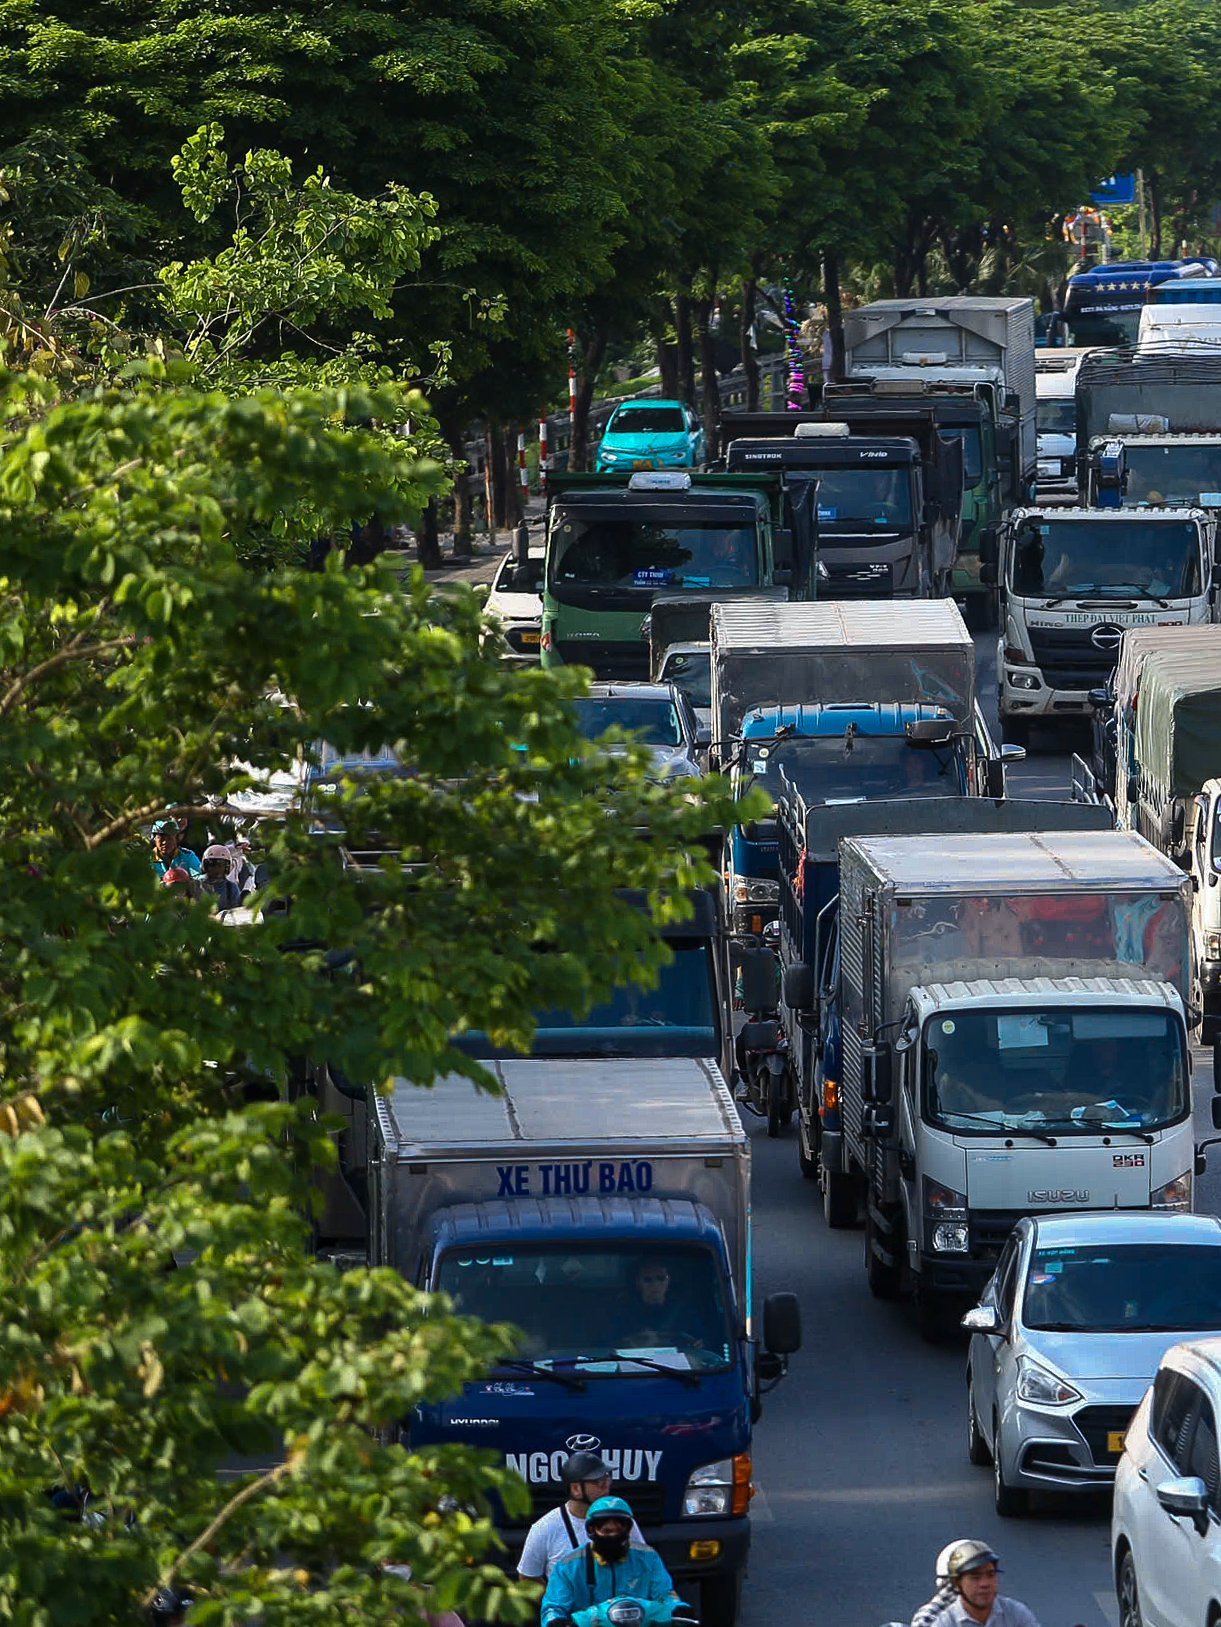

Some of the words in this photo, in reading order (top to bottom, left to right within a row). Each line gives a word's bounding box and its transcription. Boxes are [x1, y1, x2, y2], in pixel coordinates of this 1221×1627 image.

[496, 1165, 529, 1196] XE
[538, 1160, 592, 1195] THƯ
[599, 1158, 653, 1193] BÁO
[1027, 1189, 1090, 1203] ISUZU
[601, 1449, 664, 1482] HUY
